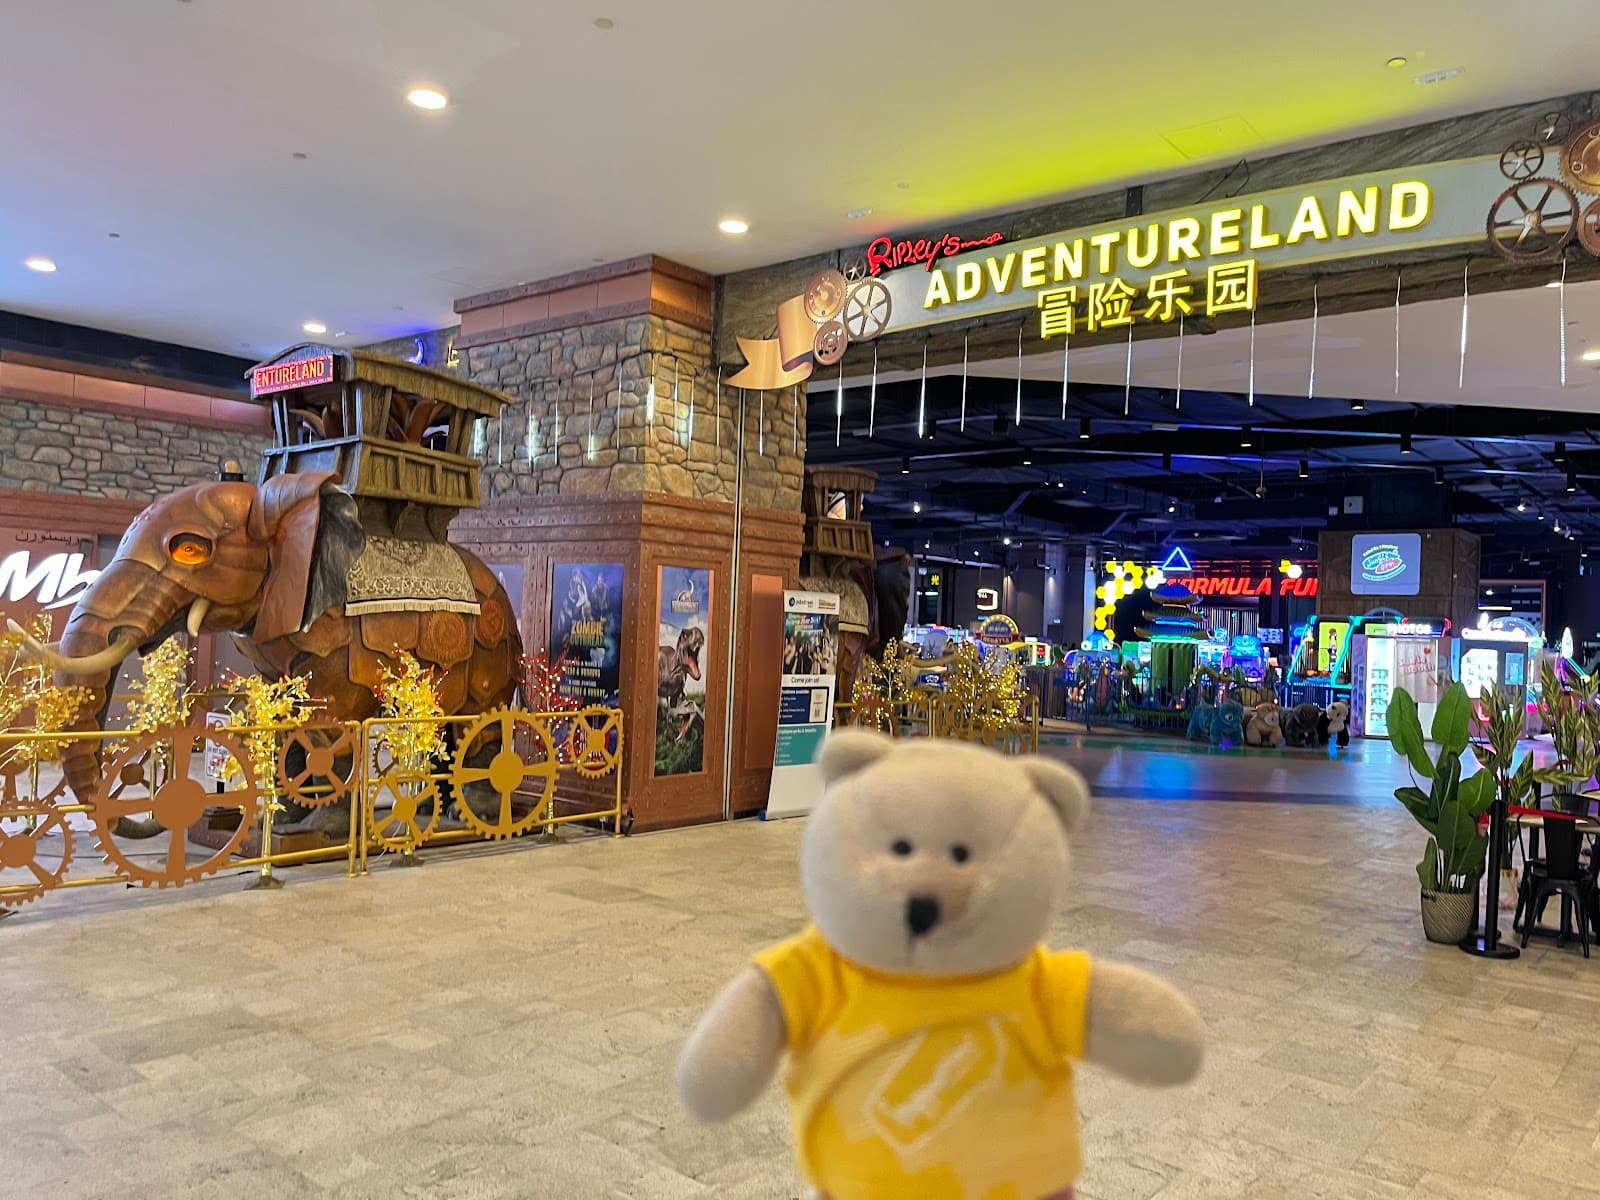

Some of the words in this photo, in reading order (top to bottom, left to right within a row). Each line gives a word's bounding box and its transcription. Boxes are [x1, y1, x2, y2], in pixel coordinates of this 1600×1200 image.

[923, 180, 1434, 309] ADVENTURELAND
[1037, 258, 1258, 338] 冒险乐园
[255, 360, 325, 388] ENTURELAND
[1387, 623, 1432, 635] PHOTOS
